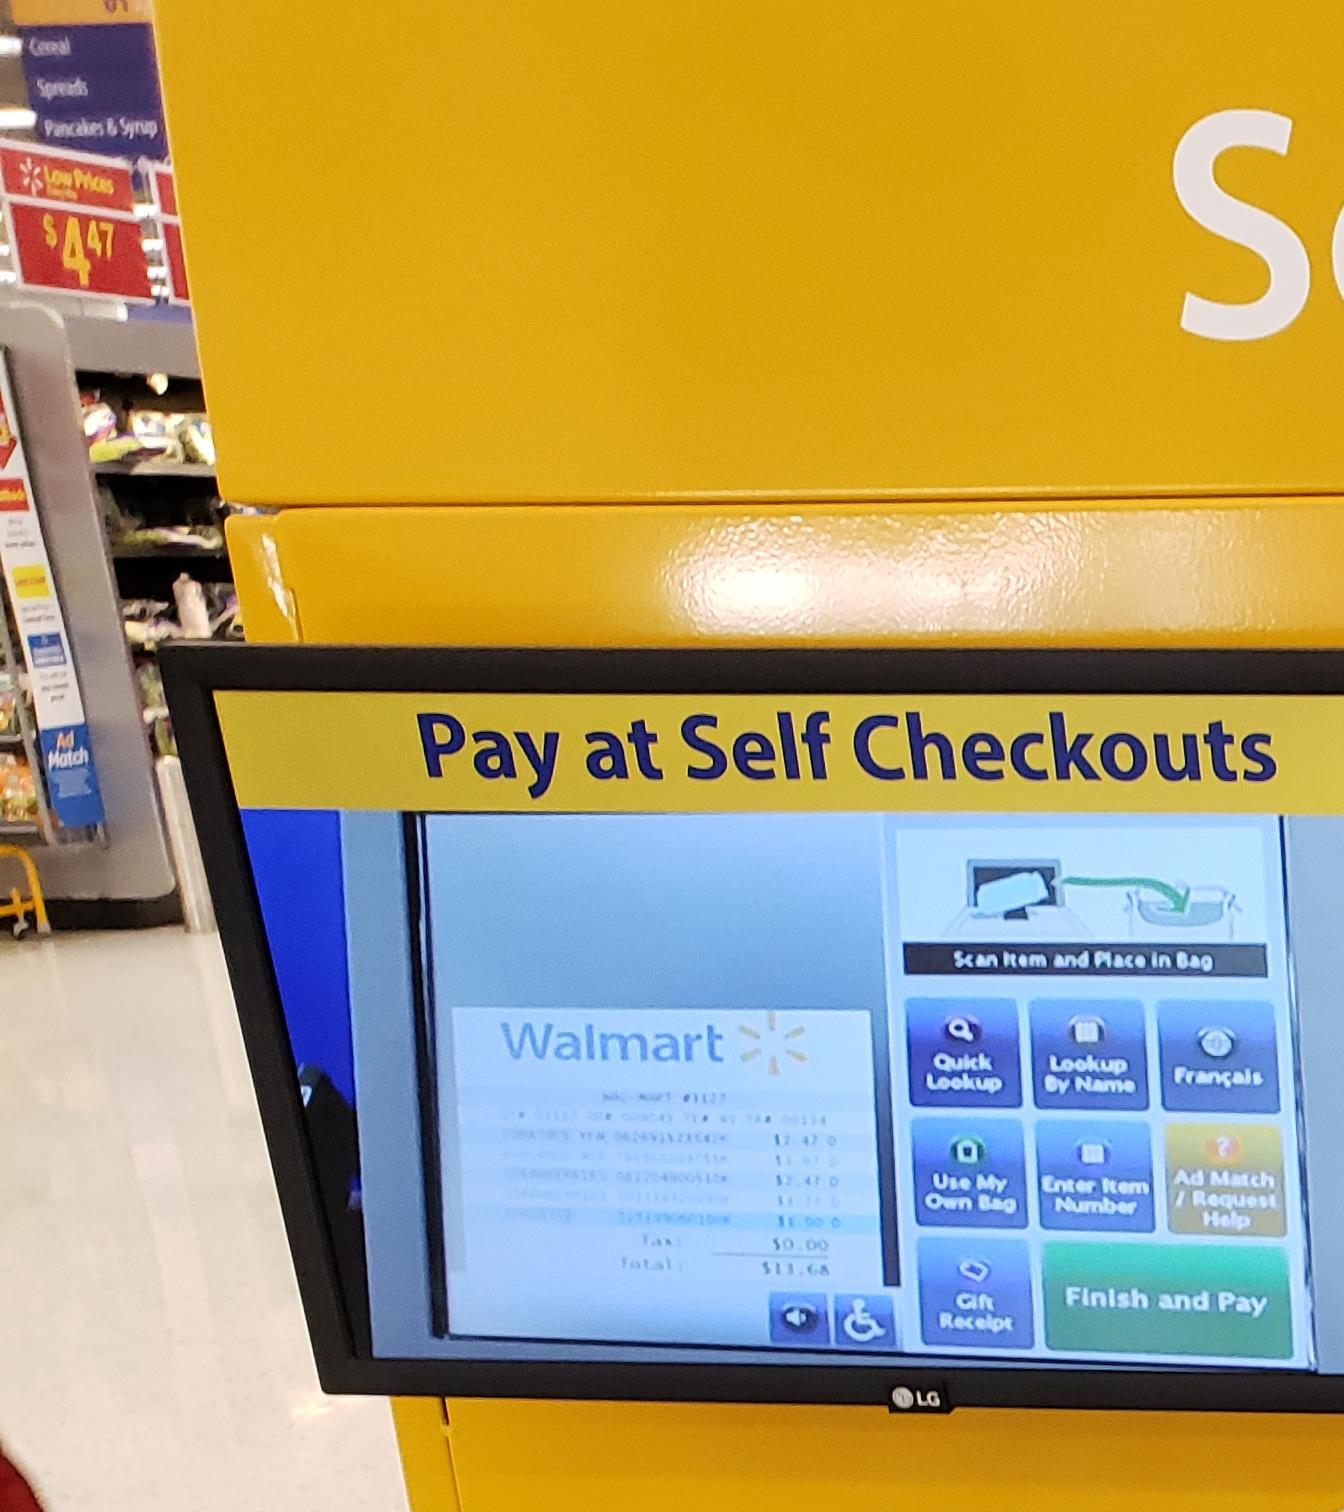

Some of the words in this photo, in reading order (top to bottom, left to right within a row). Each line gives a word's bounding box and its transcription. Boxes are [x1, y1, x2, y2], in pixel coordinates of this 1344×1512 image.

[37, 76, 88, 100] Spreads
[44, 117, 104, 138] Pancakes
[120, 117, 158, 139] Syrup
[44, 165, 73, 187] Low
[74, 168, 114, 195] Prices
[57, 730, 75, 748] Ad
[49, 747, 89, 770] Match
[415, 713, 561, 798] Pay
[584, 720, 663, 780] at
[681, 711, 831, 783] Self
[853, 711, 1277, 782] Checkouts
[954, 951, 998, 969] Scan
[1003, 951, 1047, 968] Item
[1053, 950, 1089, 968] and
[1094, 951, 1146, 969] Place
[1151, 952, 1172, 968] in
[1176, 951, 1213, 971] Bag
[501, 1022, 725, 1063] Walmart
[934, 1054, 993, 1072] Quick
[1050, 1055, 1128, 1075] Lookup
[927, 1074, 1002, 1094] Lookup
[1044, 1076, 1070, 1094] By
[1075, 1078, 1136, 1094] Name
[1174, 1068, 1263, 1087] Français
[932, 1173, 972, 1191] Use
[976, 1174, 1008, 1194] My
[1041, 1175, 1096, 1194] Enter
[1102, 1176, 1149, 1194] Item
[1173, 1170, 1206, 1186] Ad
[1210, 1171, 1275, 1188] Match
[924, 1194, 972, 1211] Own
[978, 1197, 1017, 1215] Bag
[1055, 1197, 1137, 1215] Number
[1193, 1191, 1276, 1212] Request
[1203, 1211, 1251, 1230] Help
[956, 1293, 994, 1311] Gift
[1065, 1287, 1149, 1309] Finish
[1158, 1290, 1209, 1311] and
[1218, 1292, 1267, 1317] Pay
[939, 1313, 1014, 1332] Receipt
[916, 1390, 940, 1406] LG
